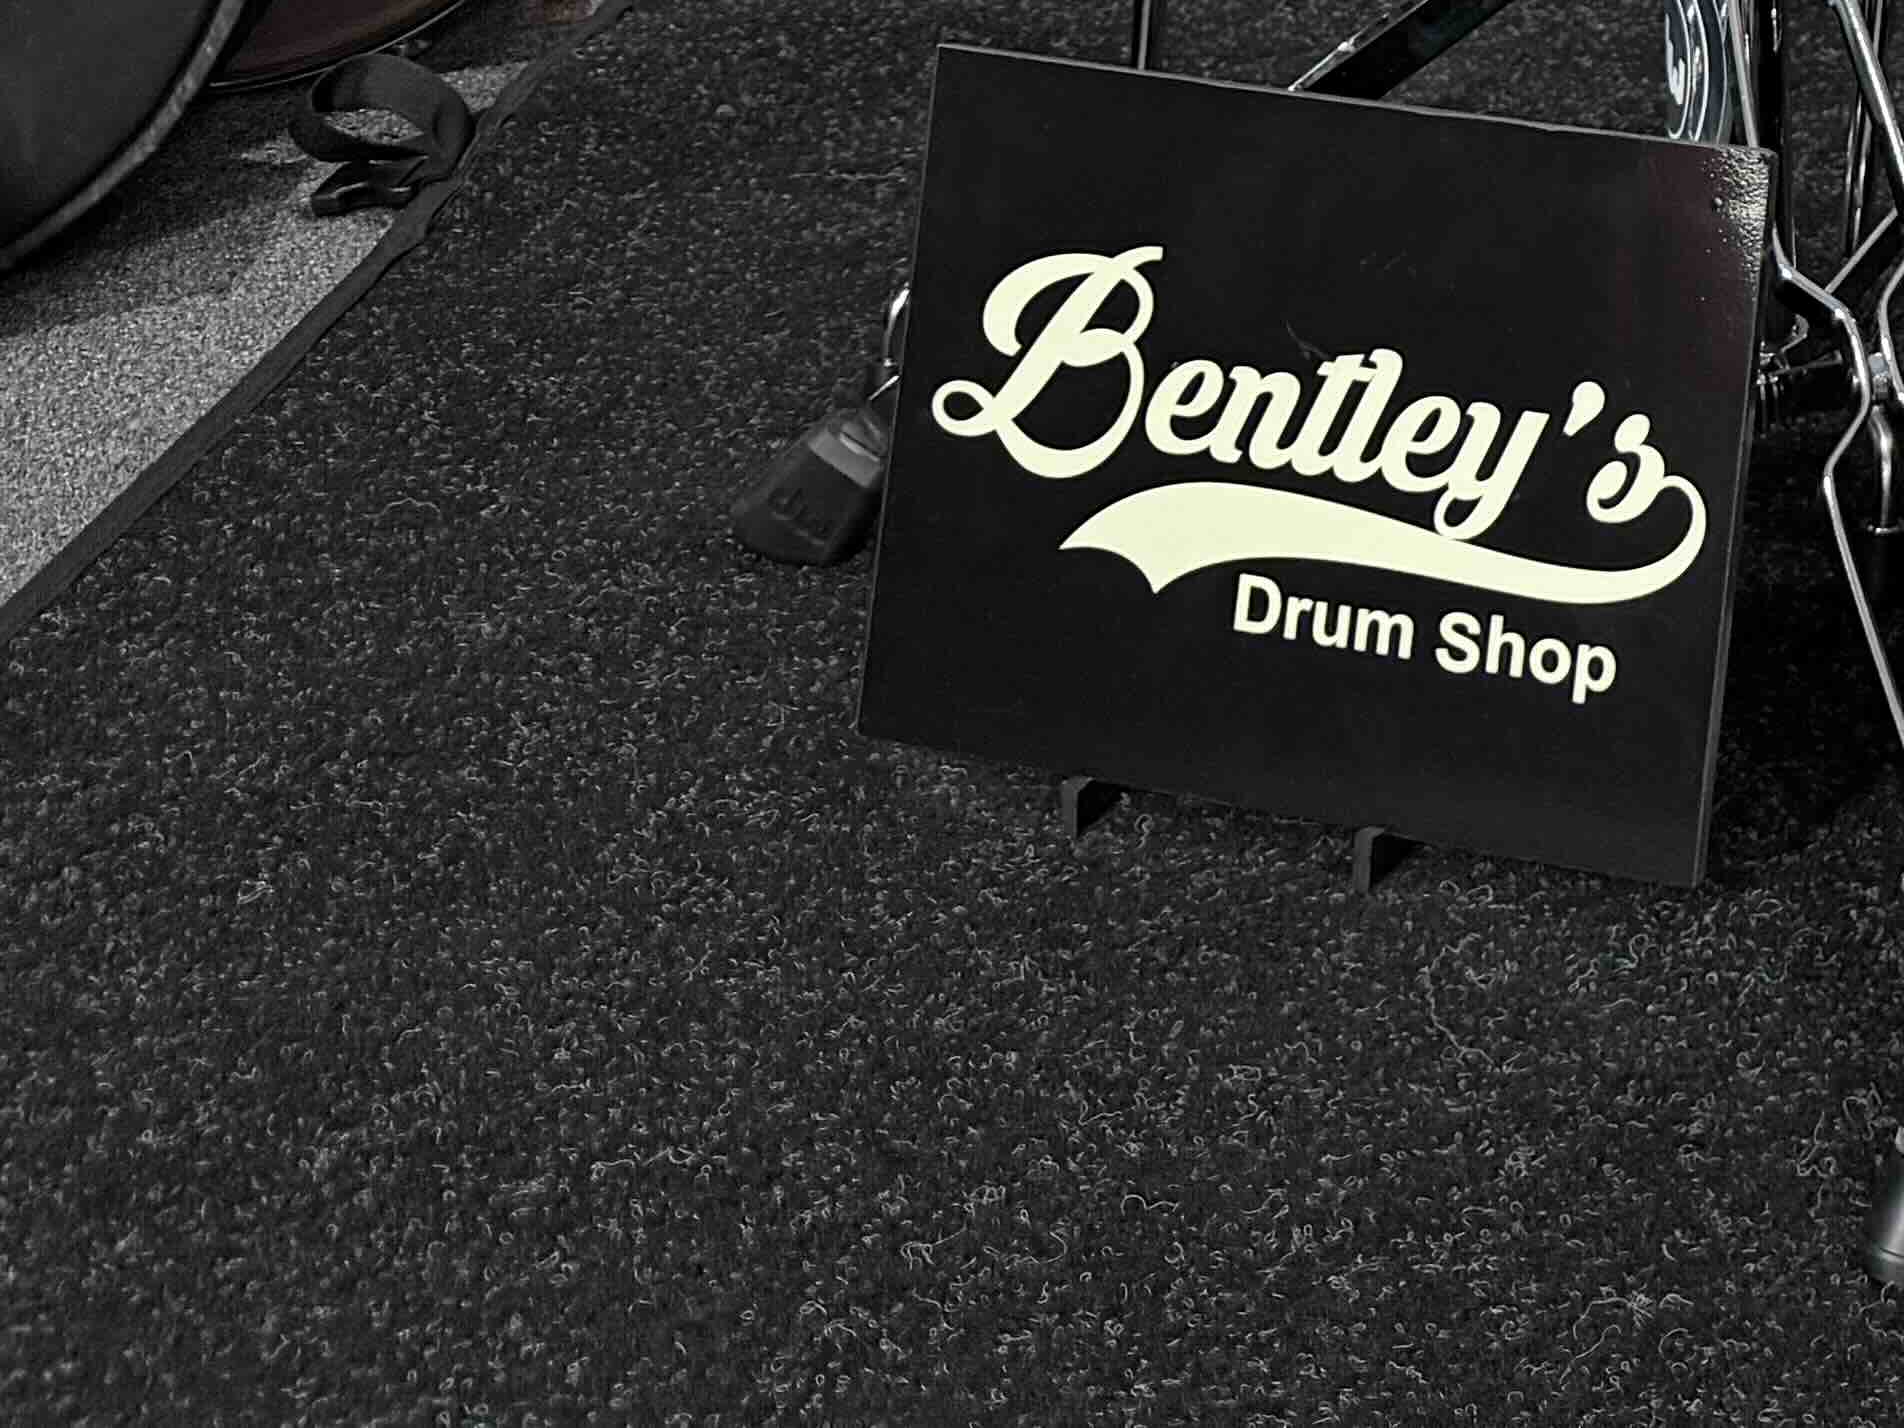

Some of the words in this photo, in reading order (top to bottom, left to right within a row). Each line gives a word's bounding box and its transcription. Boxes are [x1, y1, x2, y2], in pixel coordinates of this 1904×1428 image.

[931, 245, 1690, 544] Bentley's
[1233, 571, 1414, 662] Drum
[1436, 610, 1618, 704] Shop
